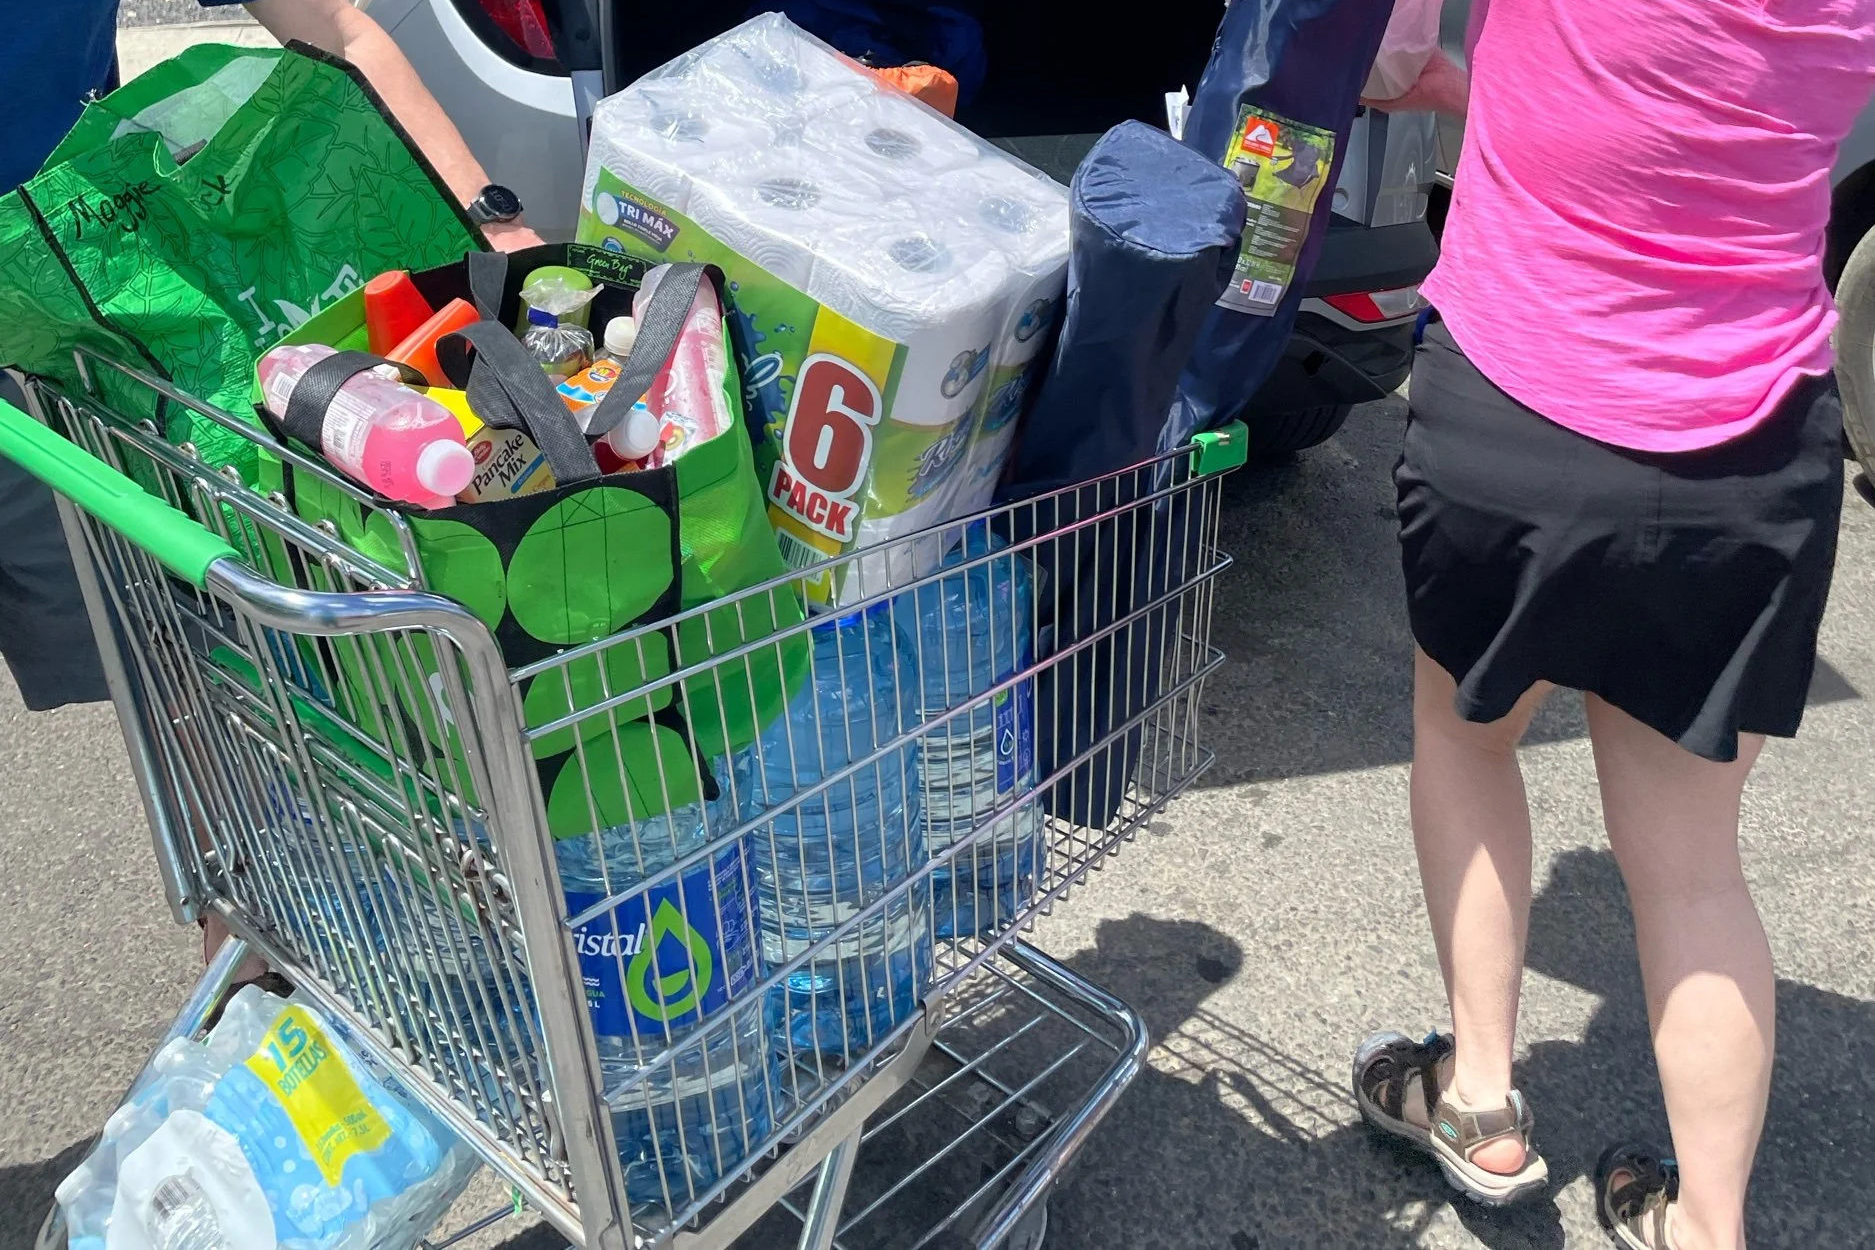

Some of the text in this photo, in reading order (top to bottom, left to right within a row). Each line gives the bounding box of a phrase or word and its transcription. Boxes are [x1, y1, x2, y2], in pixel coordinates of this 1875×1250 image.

[618, 200, 641, 220] TRI
[642, 211, 674, 239] MÁX
[788, 360, 875, 493] 6
[472, 434, 525, 496] Pancake
[498, 453, 527, 488] Mix
[771, 468, 852, 536] PACK
[574, 922, 645, 957] istal
[267, 1017, 308, 1073] 15
[278, 1040, 328, 1097] BOTELLAS
